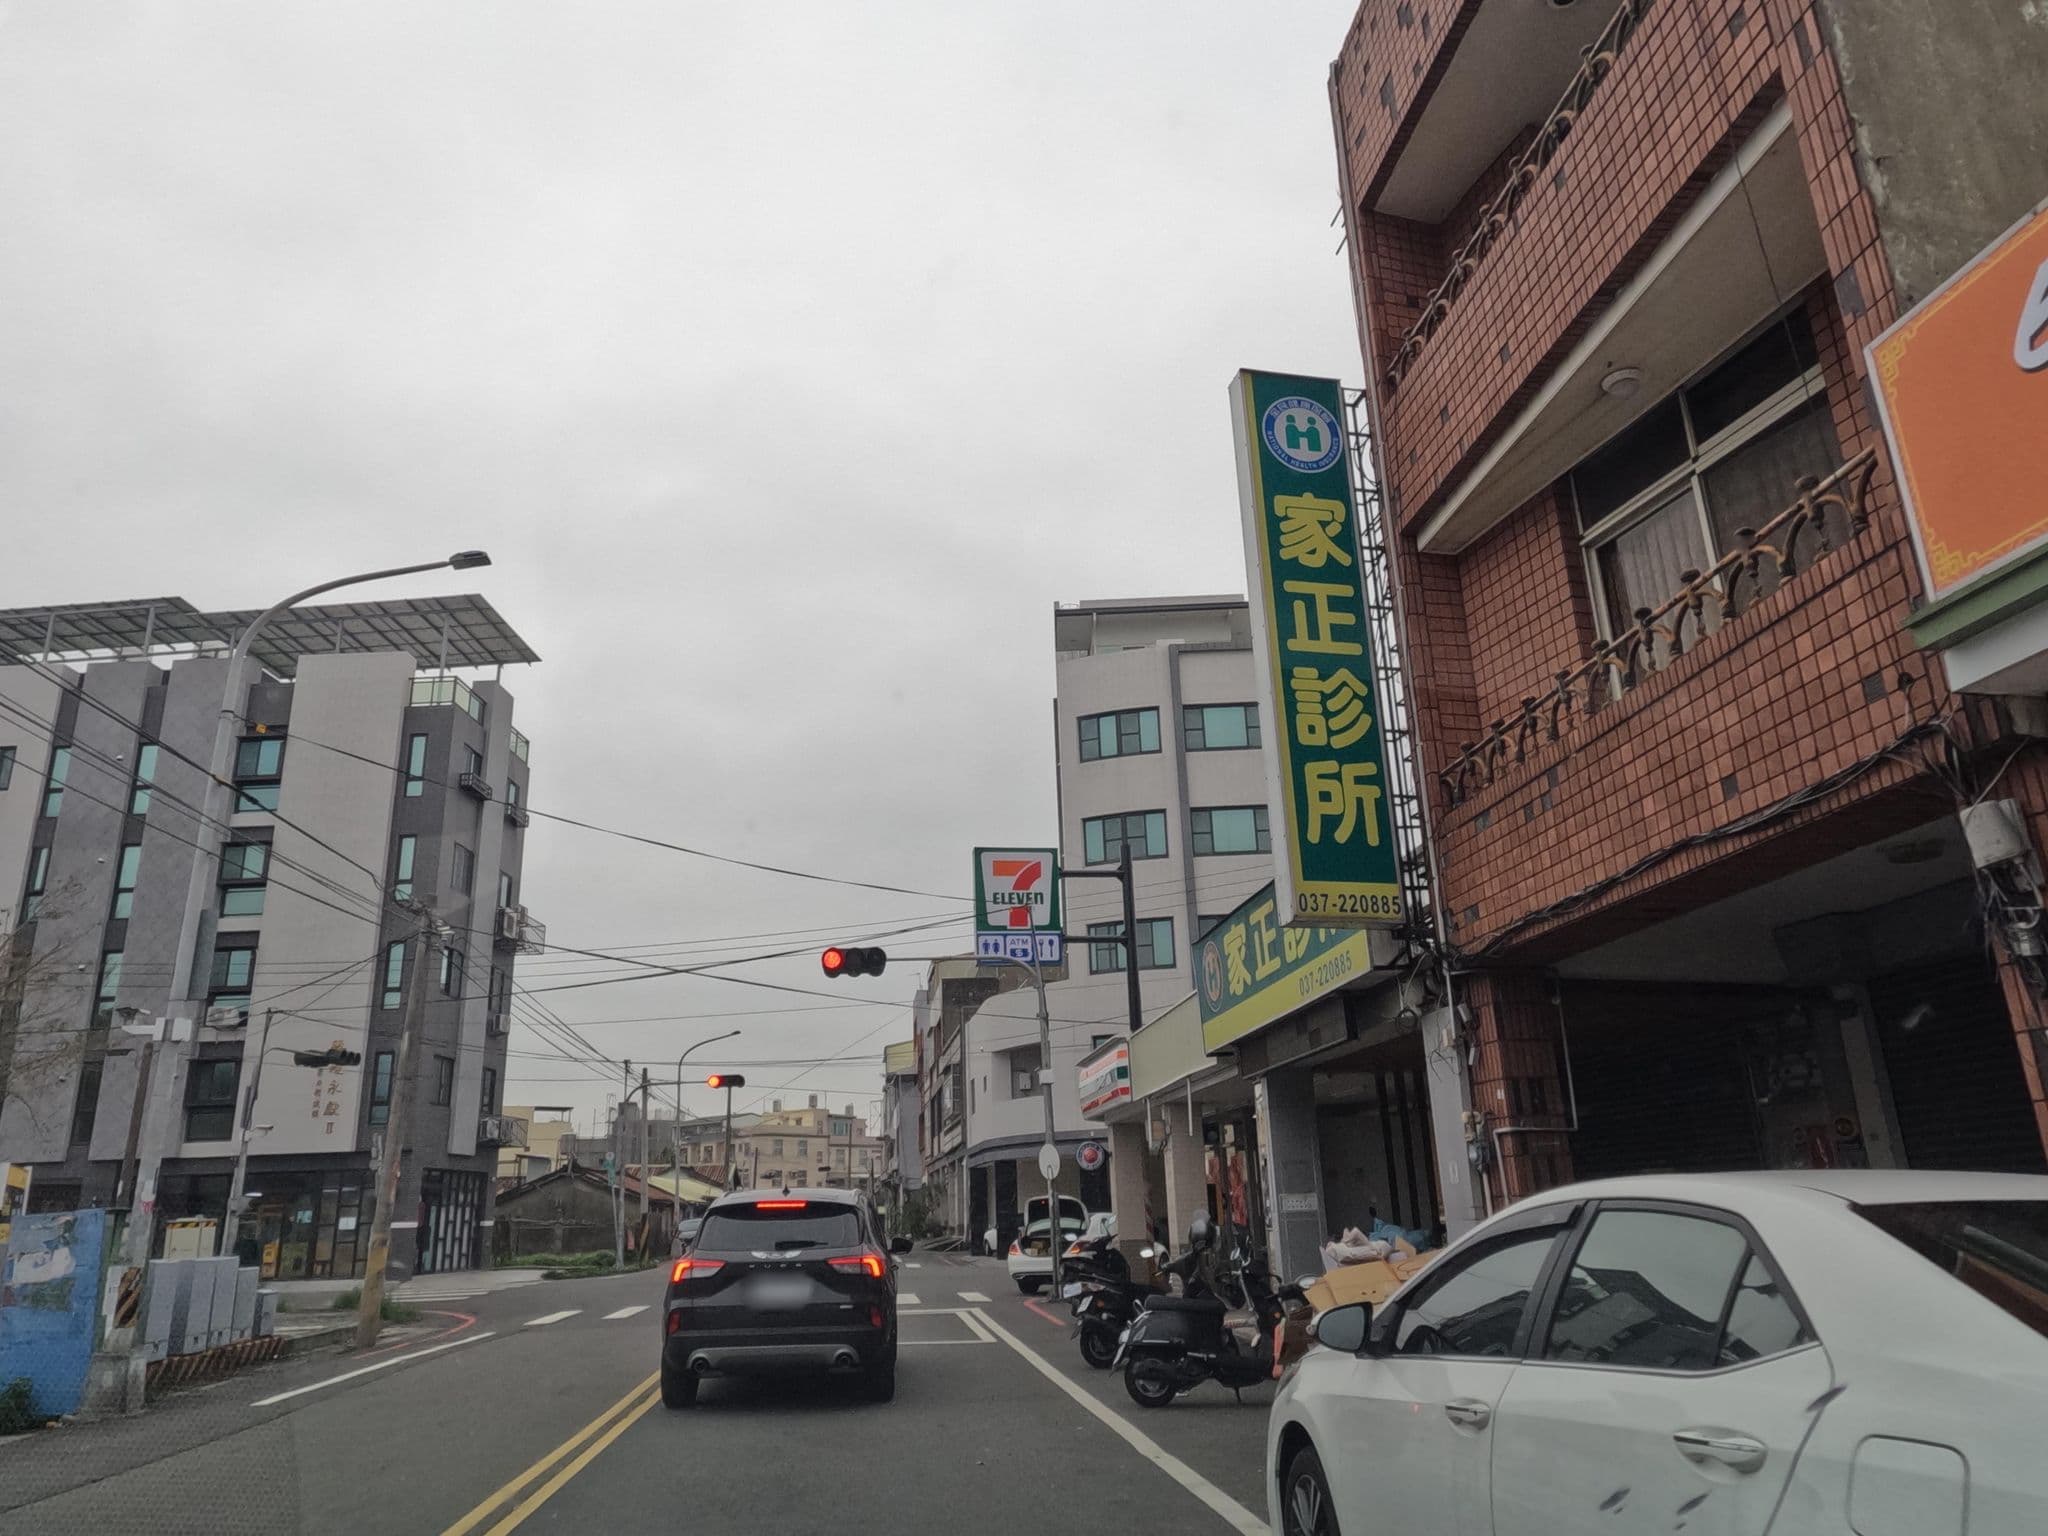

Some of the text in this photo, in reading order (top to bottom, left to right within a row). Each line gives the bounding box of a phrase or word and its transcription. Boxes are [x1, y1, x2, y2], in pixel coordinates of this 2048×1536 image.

[1273, 491, 1382, 848] 家正診所
[992, 859, 1042, 926] 7
[1298, 893, 1401, 917] 037-220885
[1009, 938, 1028, 946] ATM
[1299, 950, 1352, 997] 037-220885
